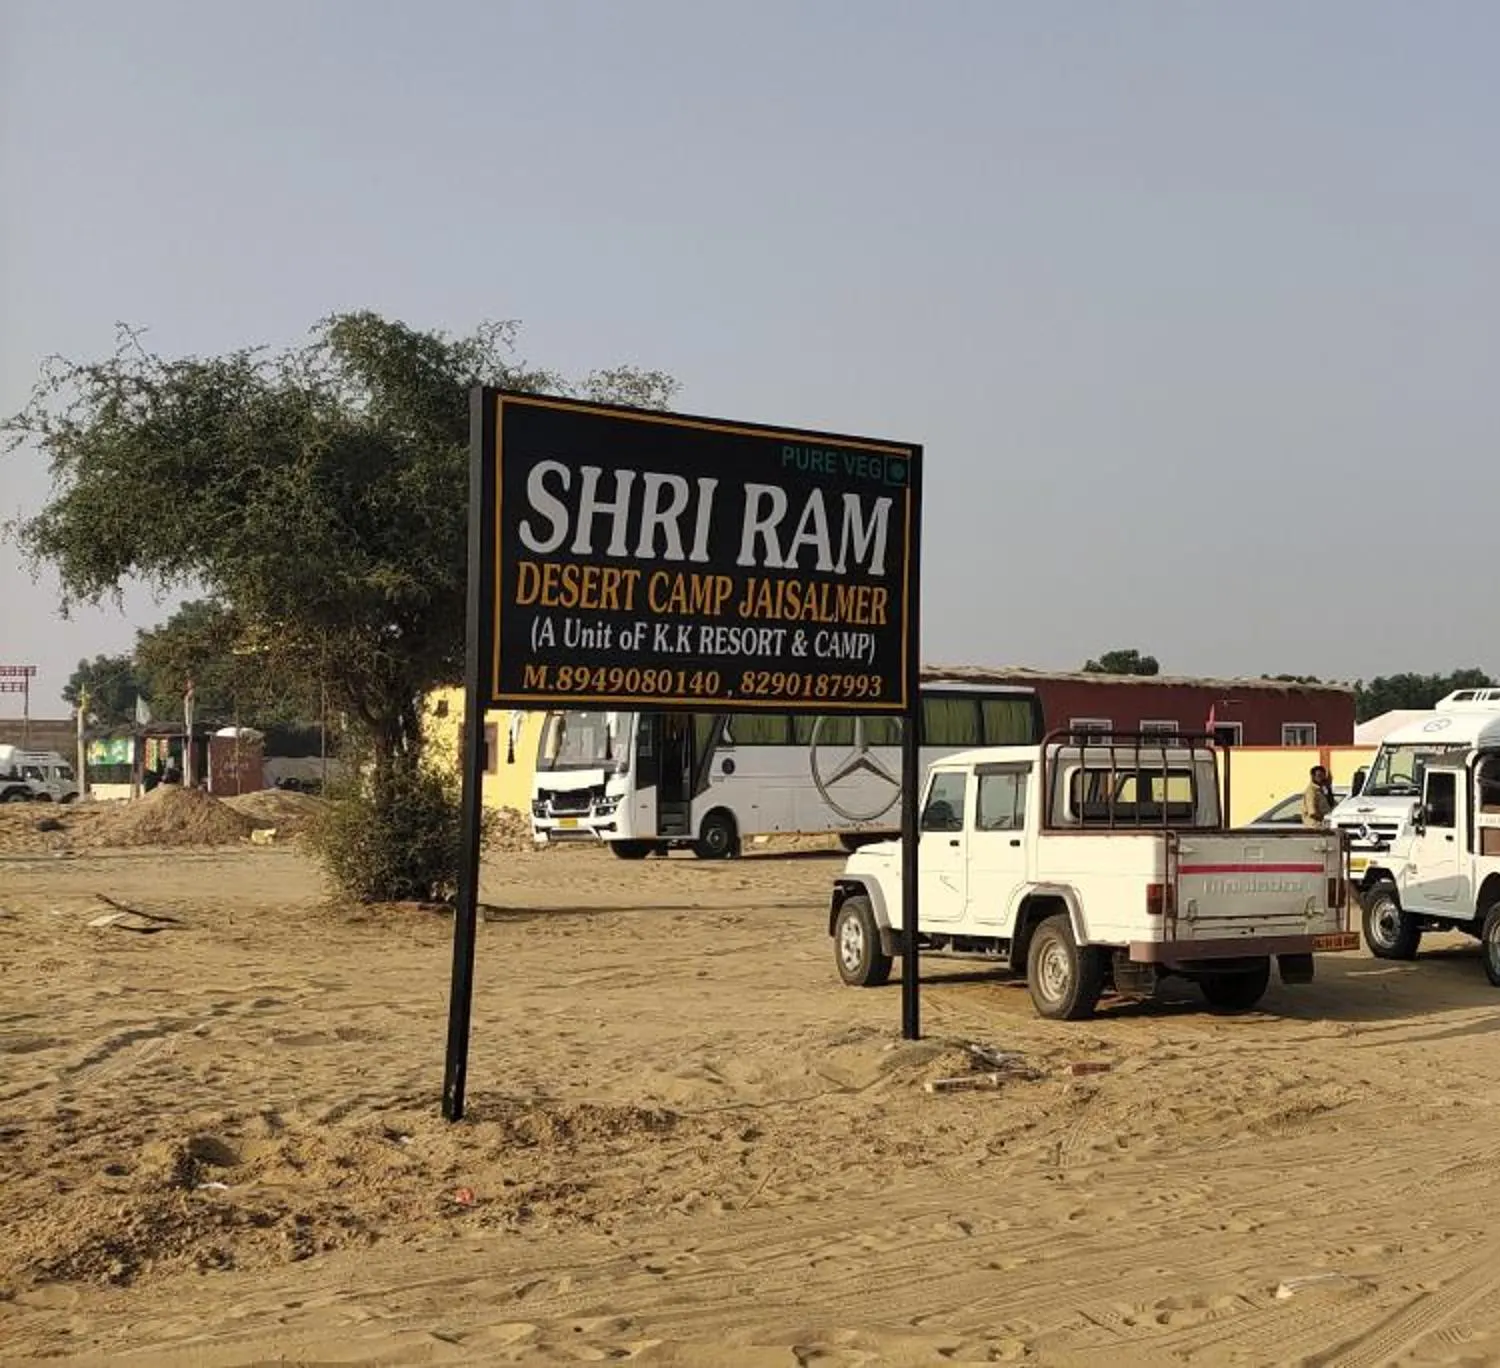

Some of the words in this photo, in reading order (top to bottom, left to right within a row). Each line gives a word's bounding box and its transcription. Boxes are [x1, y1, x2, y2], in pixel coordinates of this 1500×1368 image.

[782, 445, 837, 474] PURE
[844, 453, 881, 479] VEG
[519, 460, 719, 563] SHRI
[736, 483, 893, 576] RAM
[516, 560, 640, 612] DESERT
[648, 571, 733, 617] CAMP
[739, 577, 888, 625] JAISALMER
[531, 615, 556, 653] (A
[565, 618, 611, 650] Unit
[653, 623, 692, 654] K.K
[699, 626, 787, 656] RESORT
[791, 630, 808, 658] &
[814, 631, 876, 666] CAMP)
[523, 665, 719, 695] M.8949080140
[741, 671, 882, 697] 8290187993
